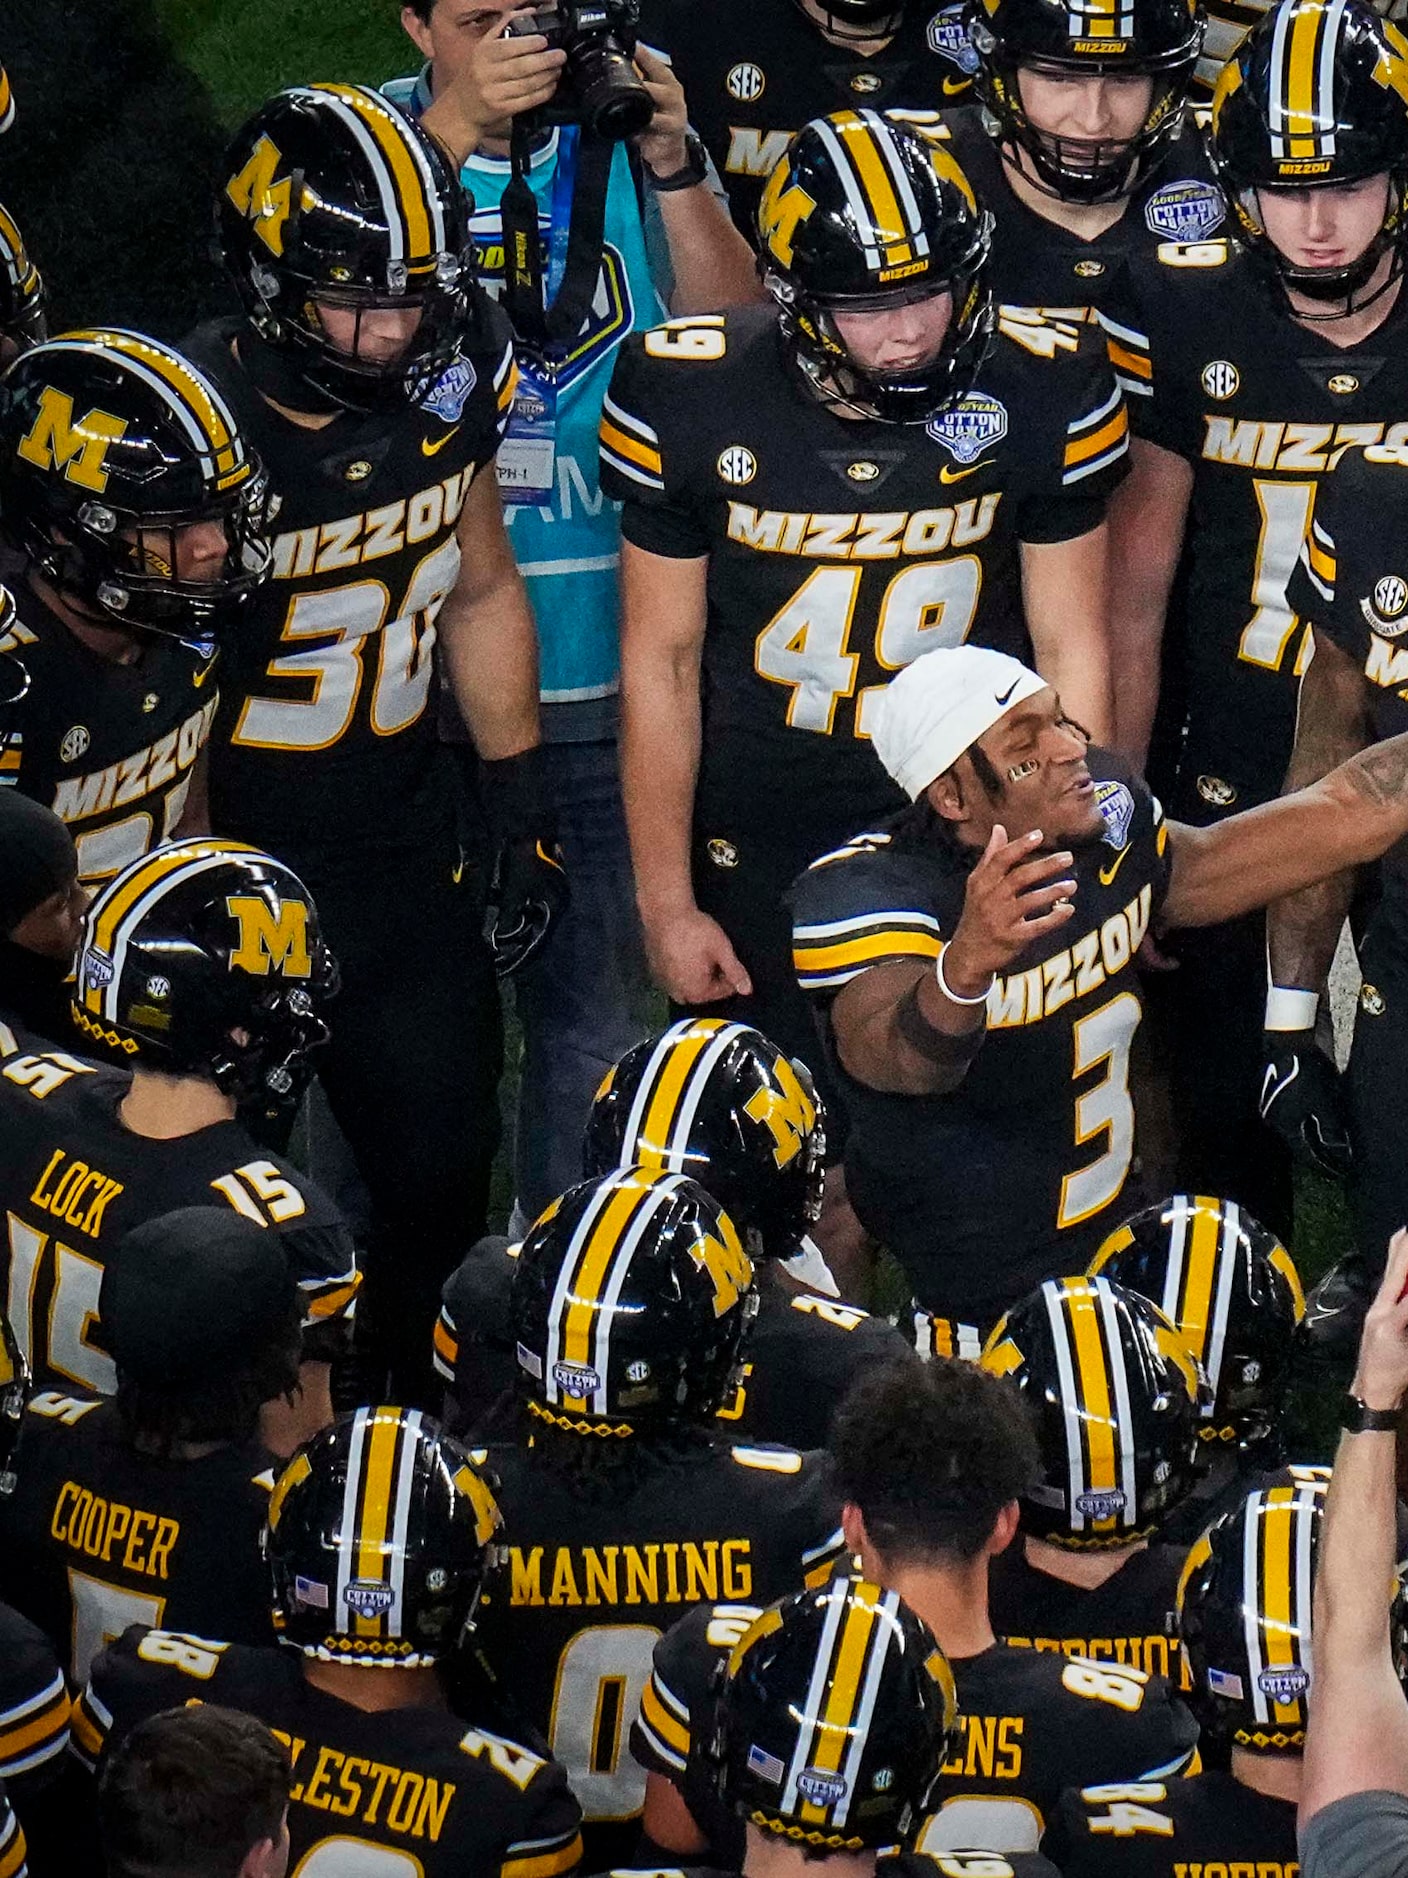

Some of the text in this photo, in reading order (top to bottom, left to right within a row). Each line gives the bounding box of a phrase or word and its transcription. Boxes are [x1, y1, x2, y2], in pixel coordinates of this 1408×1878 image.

[581, 12, 606, 23] Nikon
[1073, 41, 1127, 54] MIZZOU
[731, 65, 763, 99] SEC
[1278, 160, 1331, 175] MIZZOU
[1154, 197, 1222, 228] COTTON
[514, 230, 527, 269] Nikon
[878, 261, 929, 283] MIZZOU
[1205, 364, 1236, 396] SEC
[18, 386, 128, 494] M
[933, 412, 1001, 433] COTTON
[721, 450, 754, 483] SEC
[726, 492, 1003, 560] MIZZOU
[1378, 579, 1405, 613] SEC
[231, 534, 462, 751] 30
[754, 554, 983, 738] 49
[226, 895, 313, 979] M
[986, 885, 1152, 1030] MIZZOU
[743, 1054, 817, 1170] M
[1057, 992, 1142, 1229] 3
[30, 1149, 124, 1238] LOCK
[210, 1159, 306, 1229] 15
[51, 1480, 181, 1580] COOPER
[509, 1539, 753, 1607] MANNING
[549, 1623, 662, 1823] 0
